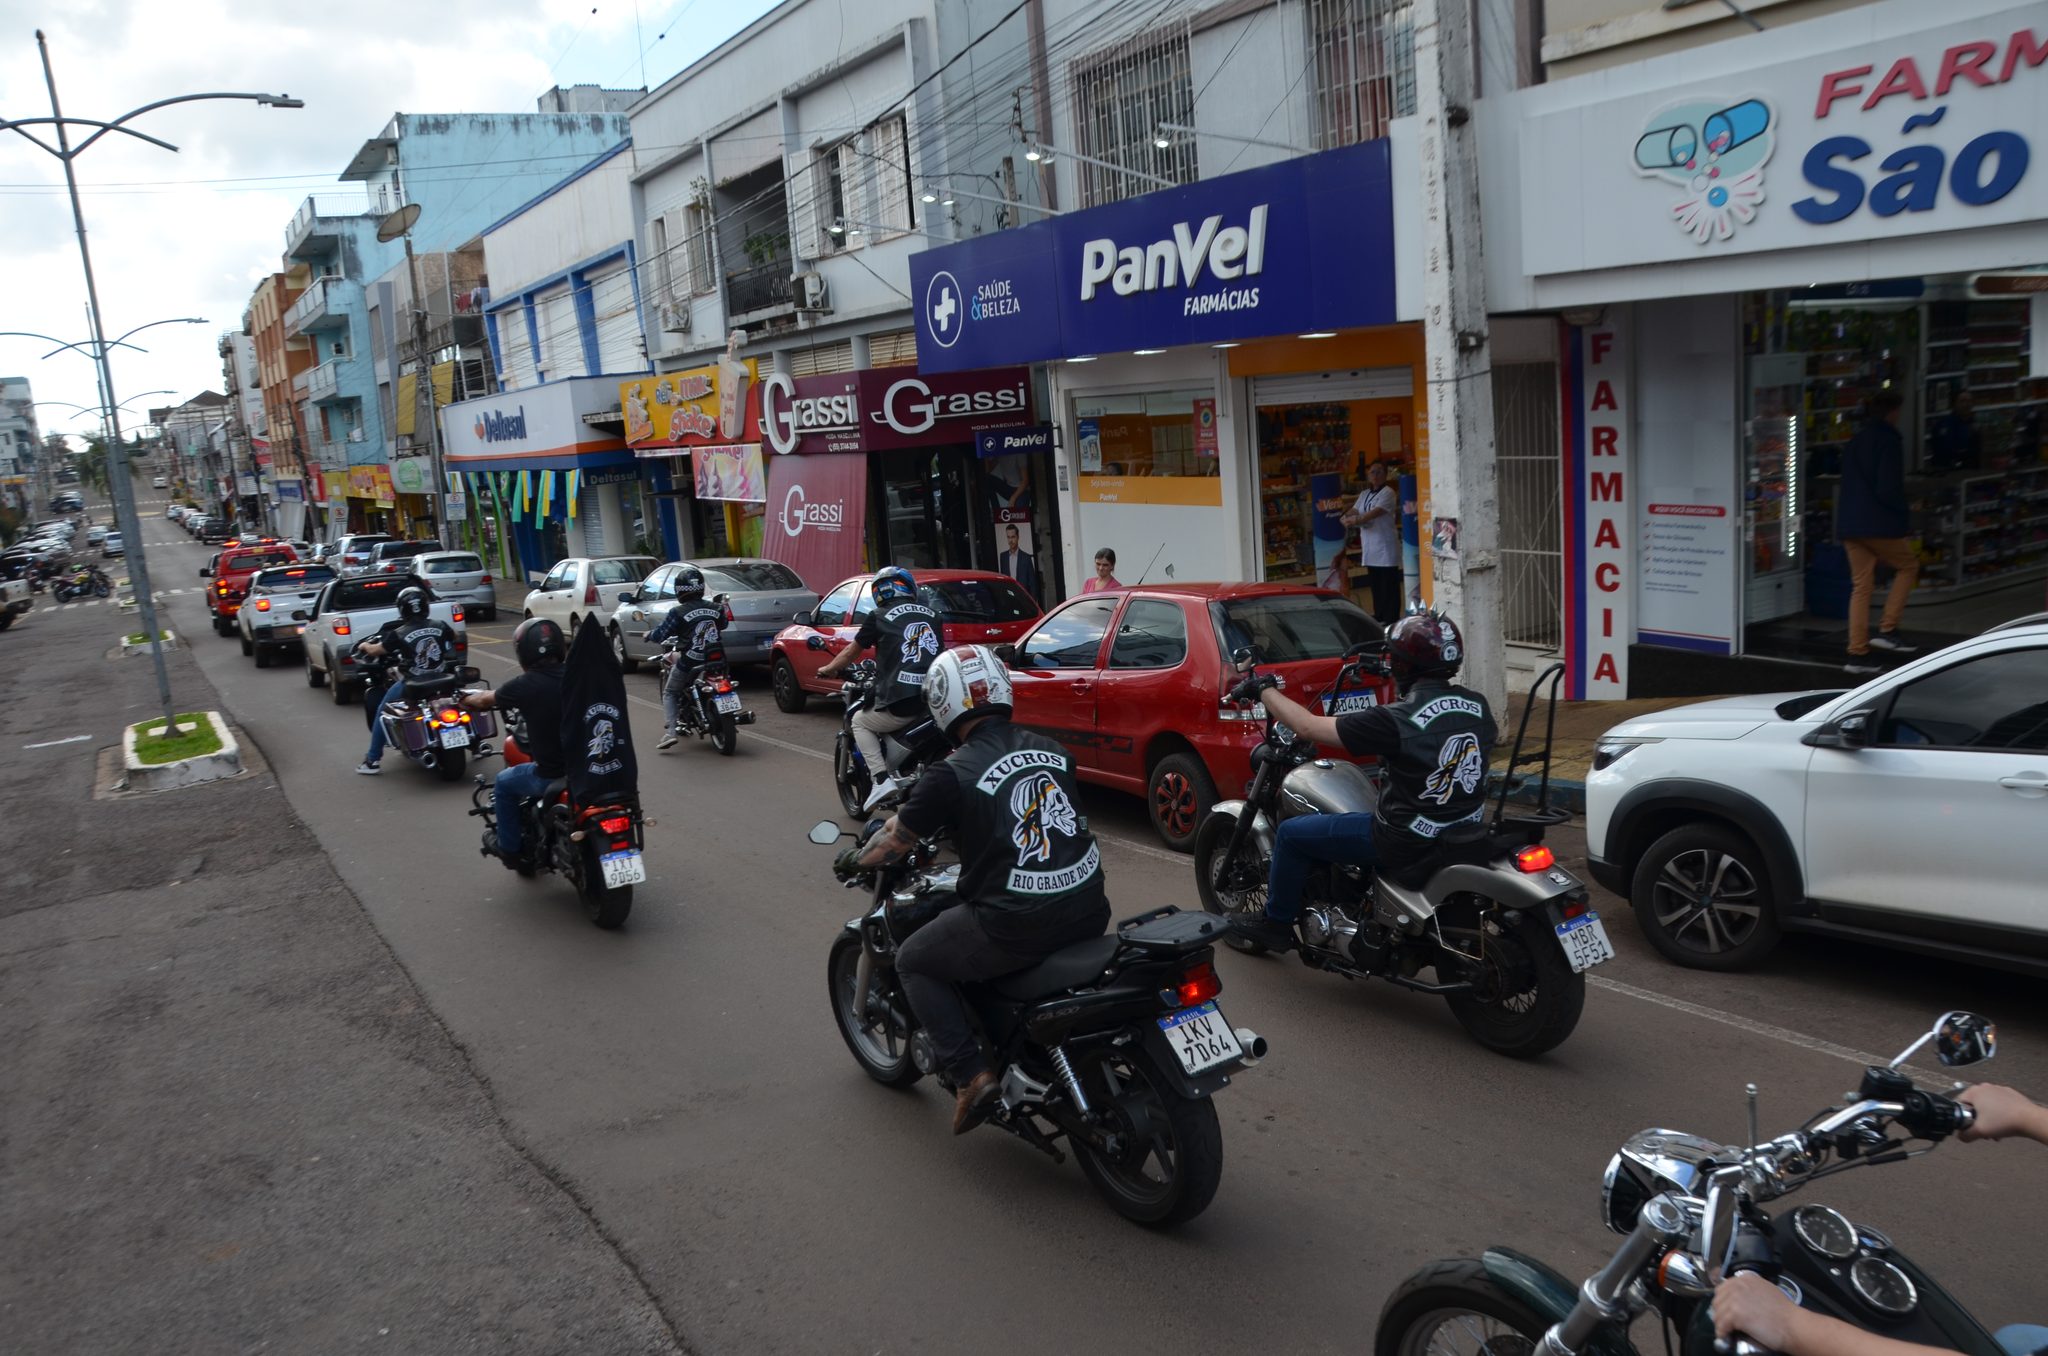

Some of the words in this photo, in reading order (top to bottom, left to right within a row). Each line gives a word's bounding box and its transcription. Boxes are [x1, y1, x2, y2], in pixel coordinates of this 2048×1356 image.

[1791, 106, 2030, 225] São
[1081, 203, 1268, 301] PanVel
[978, 279, 1012, 298] SAÚDE
[1184, 287, 1260, 317] FARMÁCIAS
[982, 297, 1020, 319] BELEZA
[758, 372, 860, 455] Grassi
[870, 378, 1026, 435] Grassi
[483, 405, 528, 443] Deltasul
[1003, 433, 1047, 449] PanVel
[590, 471, 637, 485] Deltasul
[779, 484, 843, 537] Grassi
[1590, 332, 1624, 684] FARMACIA
[889, 604, 934, 620] XUCROS
[1417, 698, 1481, 724] XUCROS
[984, 752, 1063, 789] XUCROS
[1414, 820, 1433, 835] RIO
[610, 869, 641, 885] 9D56
[612, 857, 633, 872] IXT
[1012, 873, 1034, 891] RIO
[1036, 865, 1077, 891] GRANDE
[1076, 863, 1089, 877] DO
[1087, 848, 1099, 869] SUL
[1569, 924, 1598, 949] MBR
[1573, 940, 1608, 968] 5F51
[1177, 1010, 1200, 1023] BRASIL
[1178, 1016, 1213, 1045] IKV
[1183, 1035, 1232, 1067] 7D64
